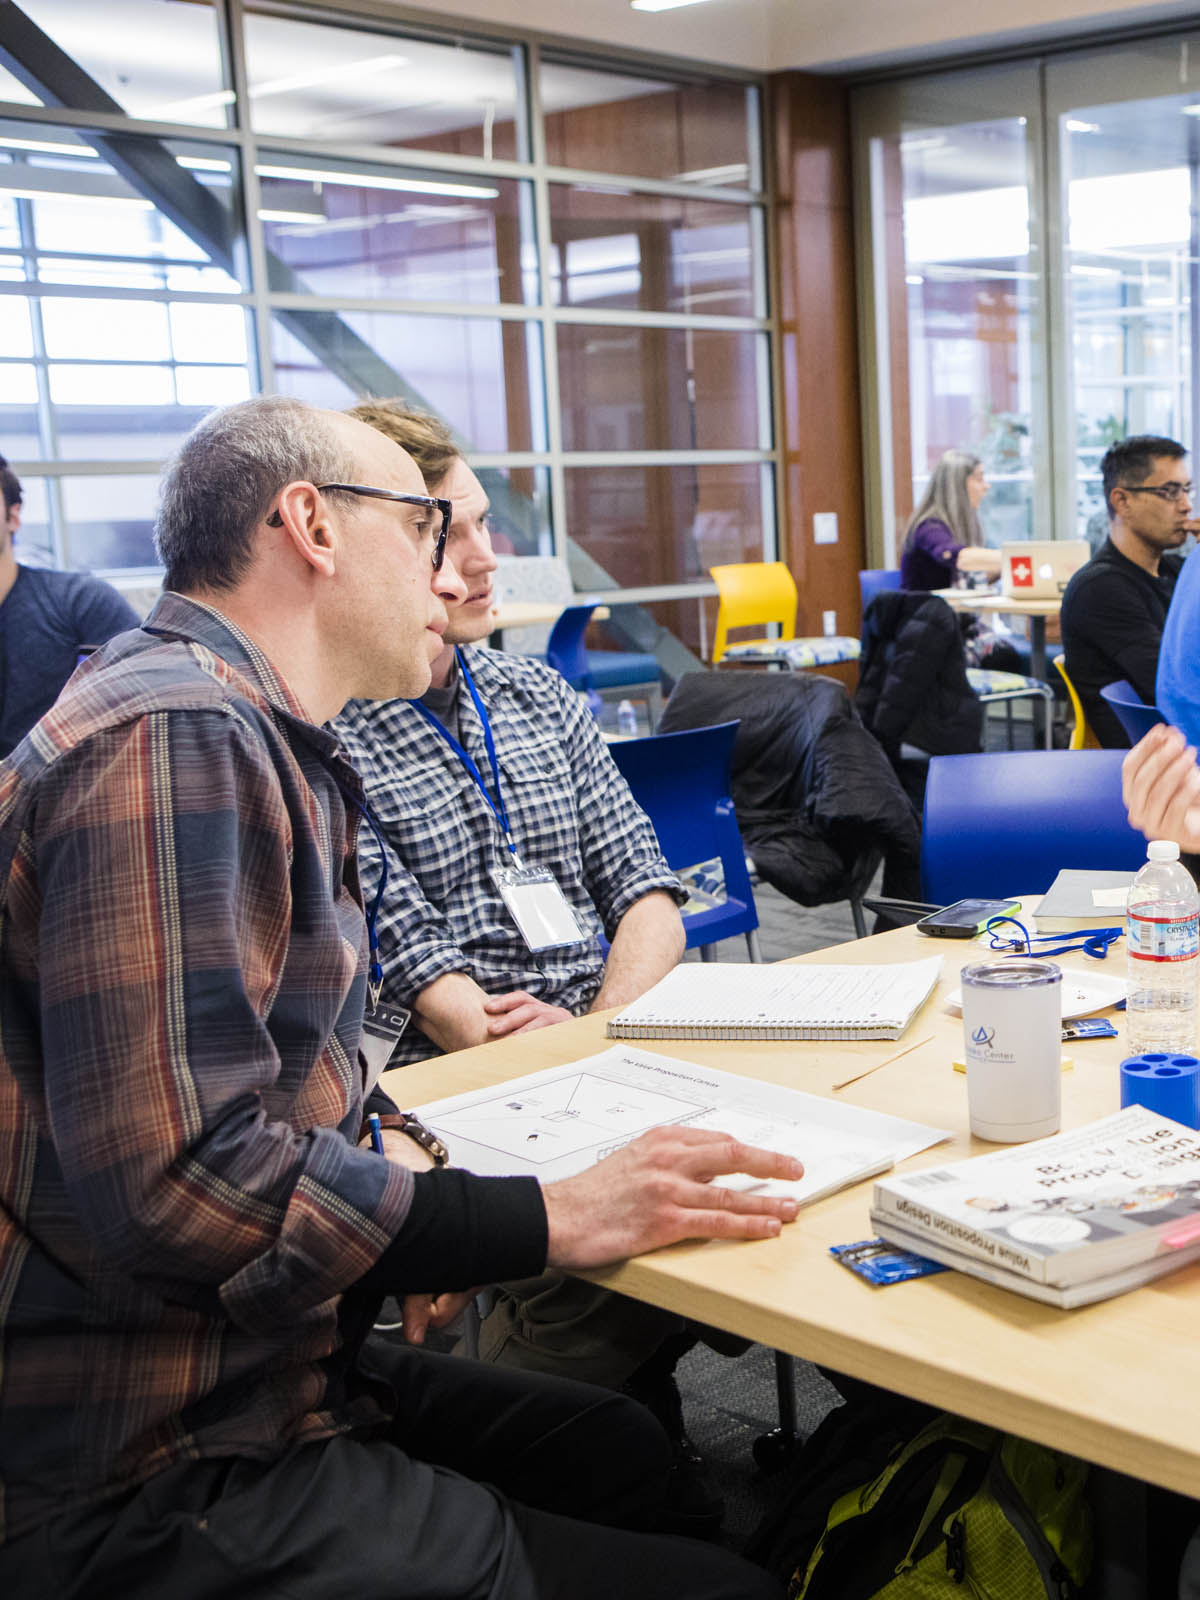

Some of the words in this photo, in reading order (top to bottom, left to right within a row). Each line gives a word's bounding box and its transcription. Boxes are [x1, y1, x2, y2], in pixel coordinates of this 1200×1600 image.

[1095, 1129, 1174, 1157] Vlue
[896, 1199, 931, 1226] Design
[933, 1216, 996, 1255] Proposition
[998, 1246, 1031, 1272] Value
